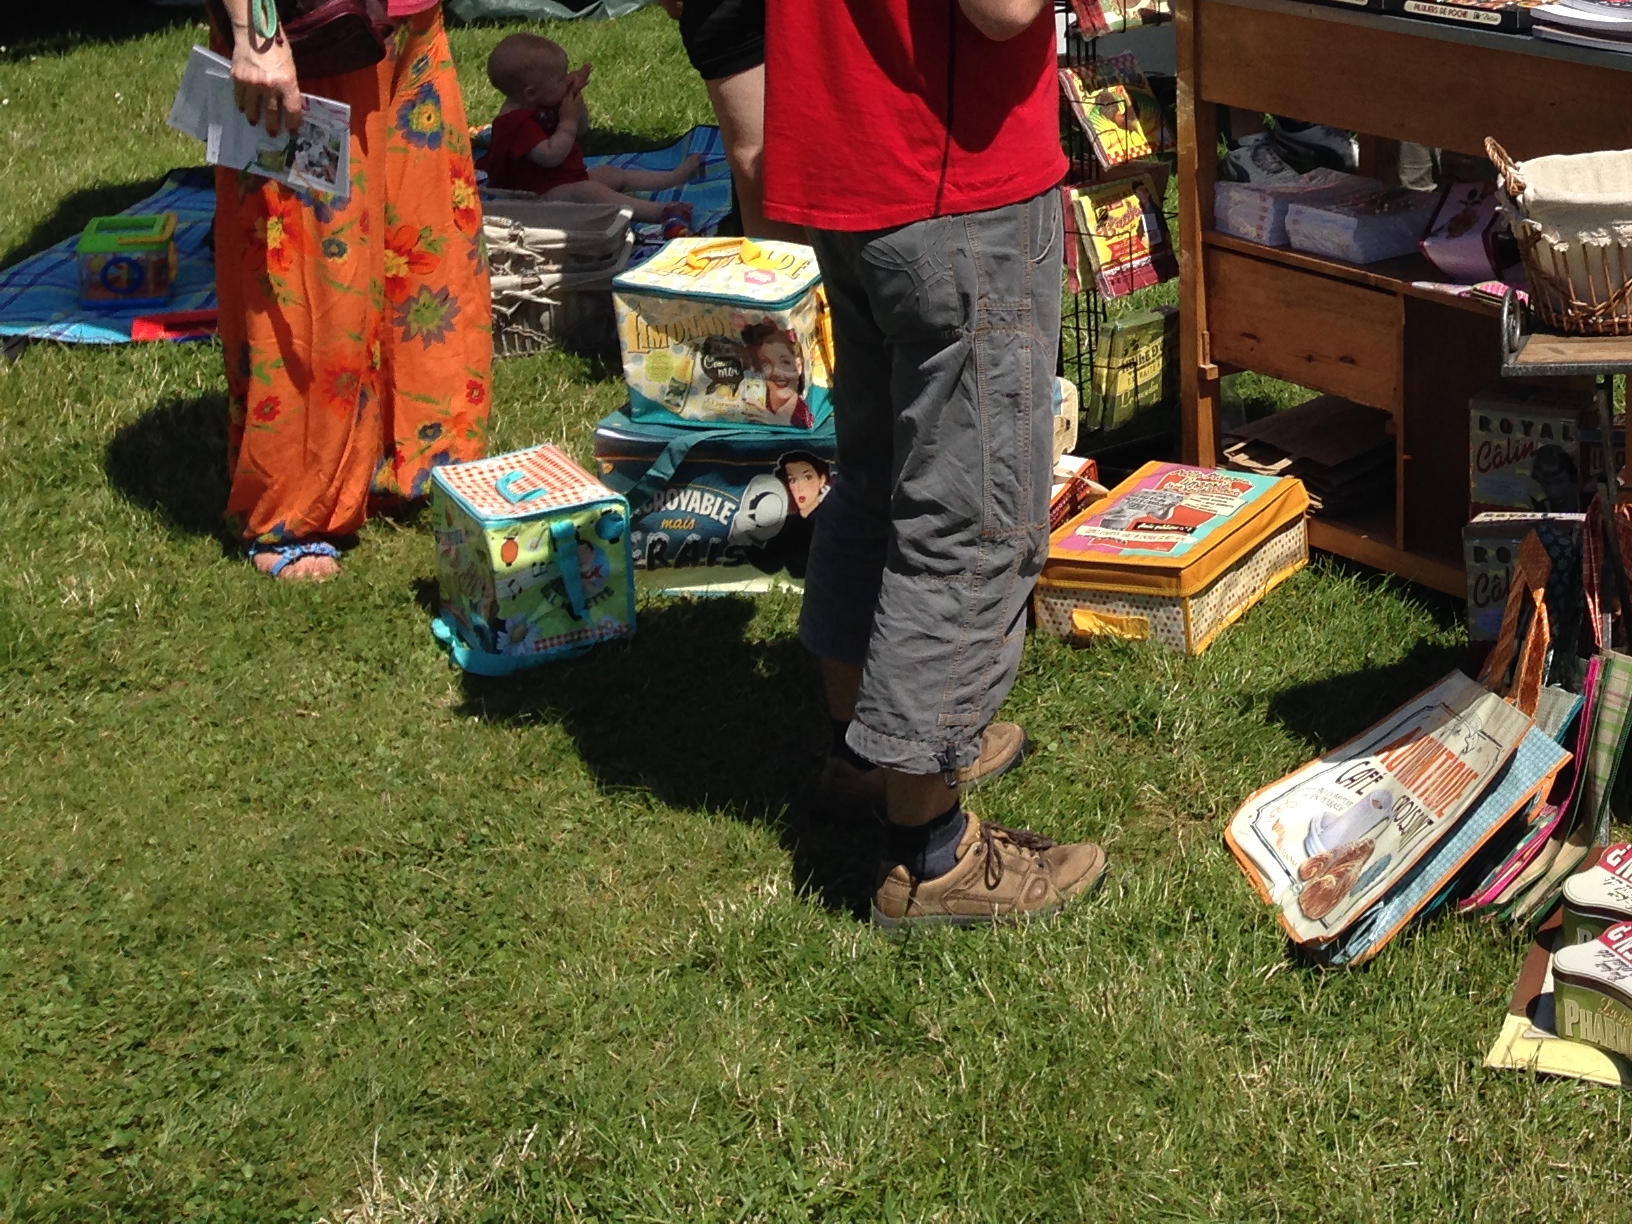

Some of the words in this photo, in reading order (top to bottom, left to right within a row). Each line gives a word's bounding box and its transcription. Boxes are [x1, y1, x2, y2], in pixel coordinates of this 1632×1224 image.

[1478, 415, 1575, 442] ROYAL
[1476, 437, 1537, 474] Câlin
[632, 487, 737, 526] CROYABLE
[661, 515, 696, 531] mais
[1334, 760, 1388, 796] CAFÉ
[1606, 844, 1632, 867] ?
